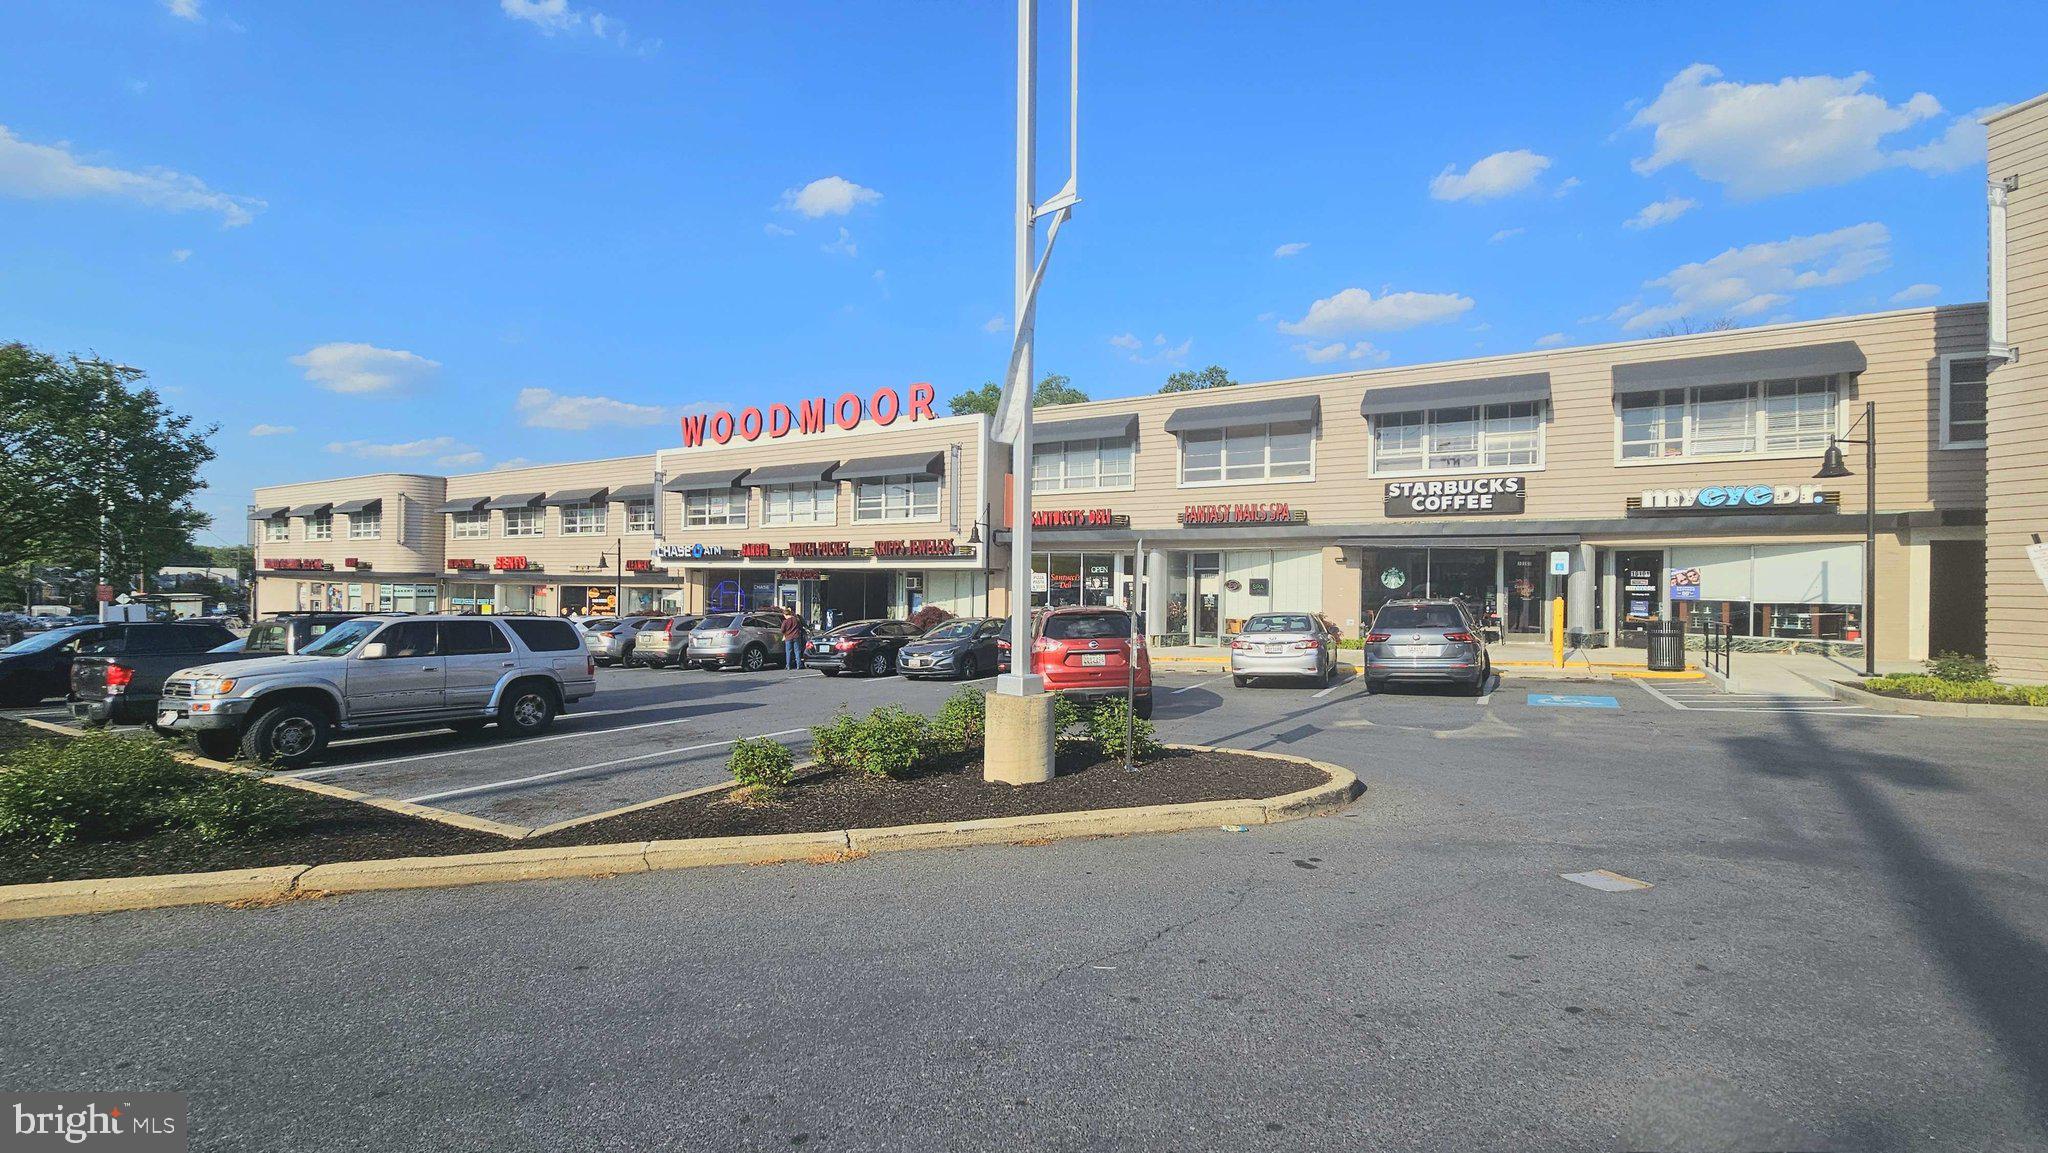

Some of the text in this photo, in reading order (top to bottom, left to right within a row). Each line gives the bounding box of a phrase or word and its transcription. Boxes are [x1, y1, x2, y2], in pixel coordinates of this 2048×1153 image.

[681, 382, 937, 448] WOODMOOR
[1388, 477, 1519, 497] STARBUCKS
[1411, 494, 1493, 511] COFFEE
[1088, 509, 1112, 525] DELI
[1185, 502, 1291, 522] FANTASY NAILS SPA
[656, 545, 722, 558] CHASE ATM
[789, 540, 850, 556] WATCH POCKET
[908, 538, 954, 555] JEWELERS
[1091, 566, 1108, 574] OPEN
